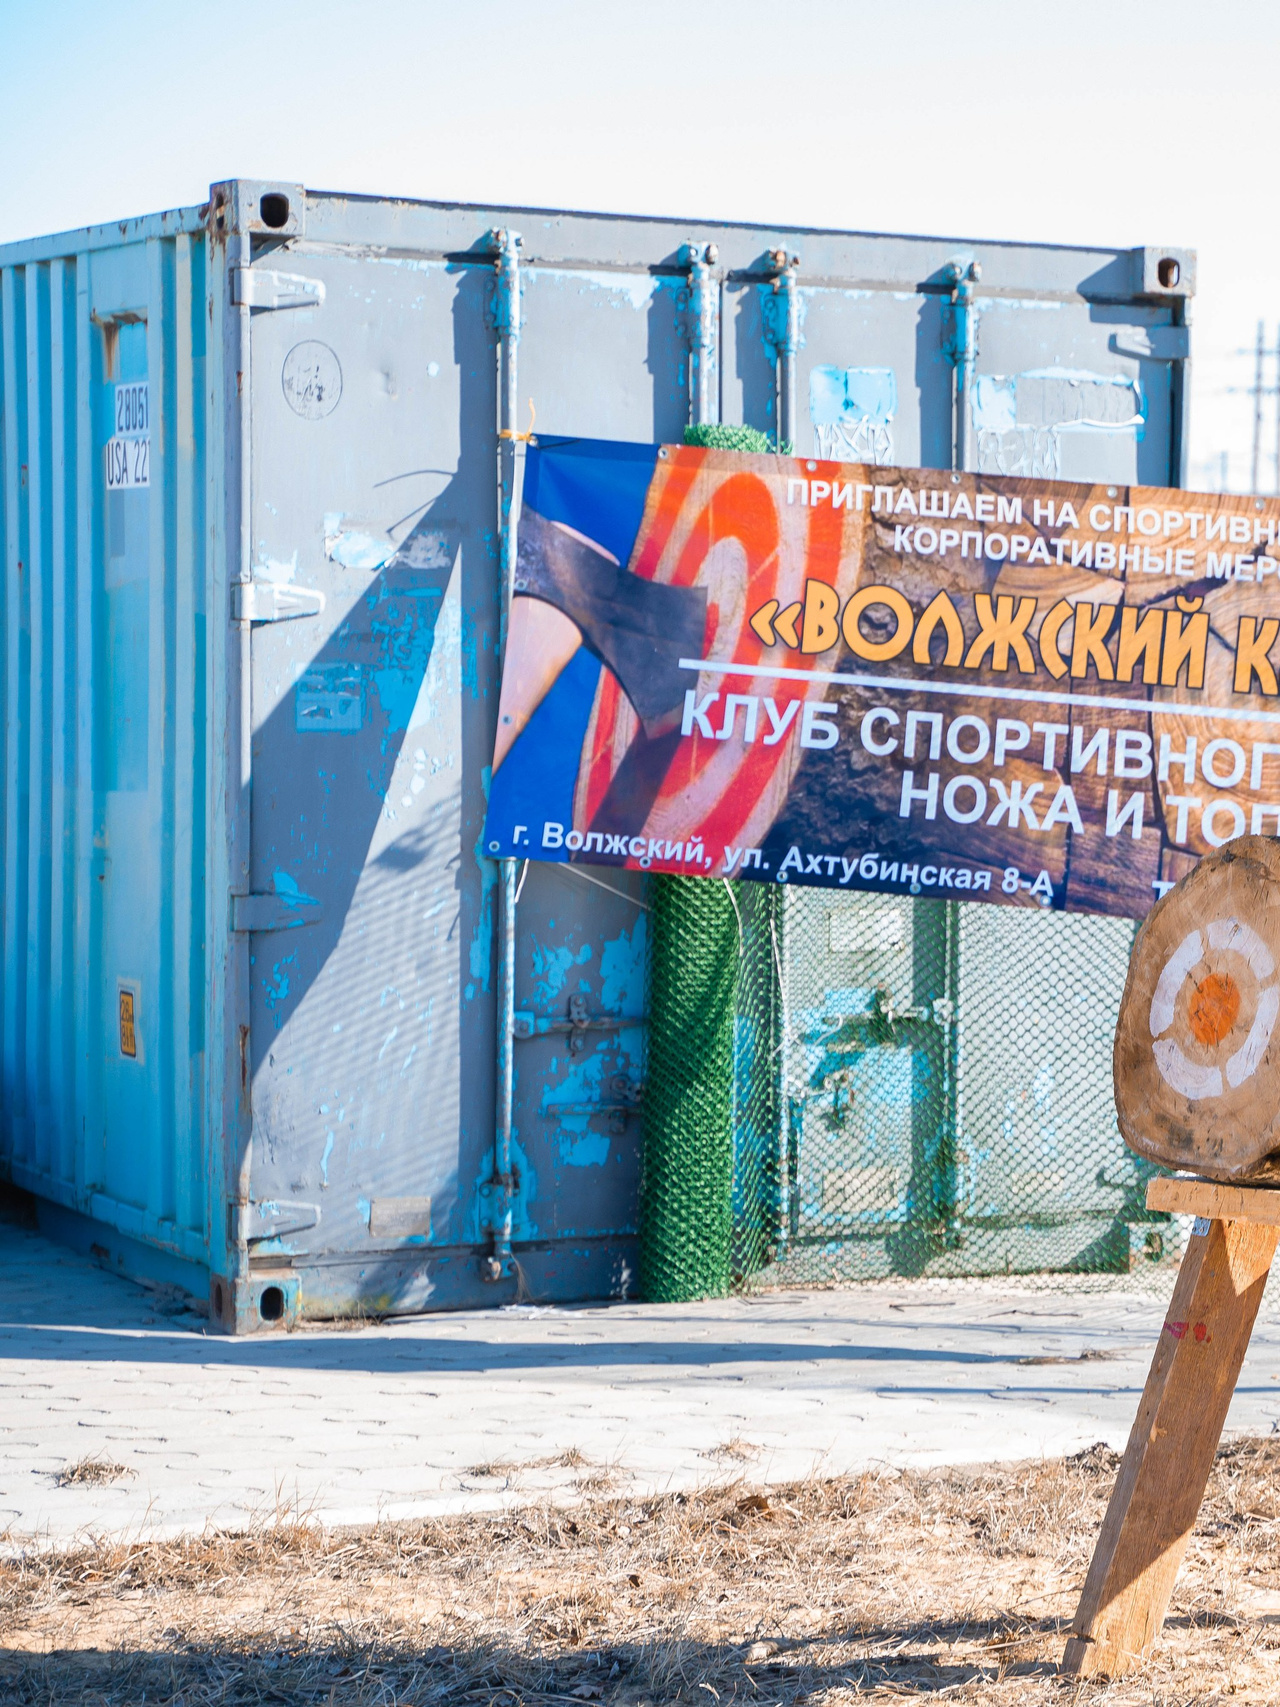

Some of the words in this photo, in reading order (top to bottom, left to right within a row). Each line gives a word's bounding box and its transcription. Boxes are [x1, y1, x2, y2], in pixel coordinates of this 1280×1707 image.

[107, 441, 129, 486] USA
[134, 439, 150, 483] 22
[786, 478, 1023, 525] ПРИГЛАШАЕМ
[1034, 500, 1079, 529] НА
[894, 524, 1195, 577] КОРПОРАТИВНЫЕ
[749, 578, 1210, 690] «ВОЛЖСКИЙ
[680, 689, 840, 751] КЛУБ
[899, 769, 1085, 835] НОЖА
[1105, 789, 1146, 840] И
[512, 825, 529, 846] г.
[541, 821, 713, 869] Волжский,
[722, 845, 770, 873] ул.
[780, 845, 992, 892] Ахтубинская
[1001, 867, 1054, 898] 8-А
